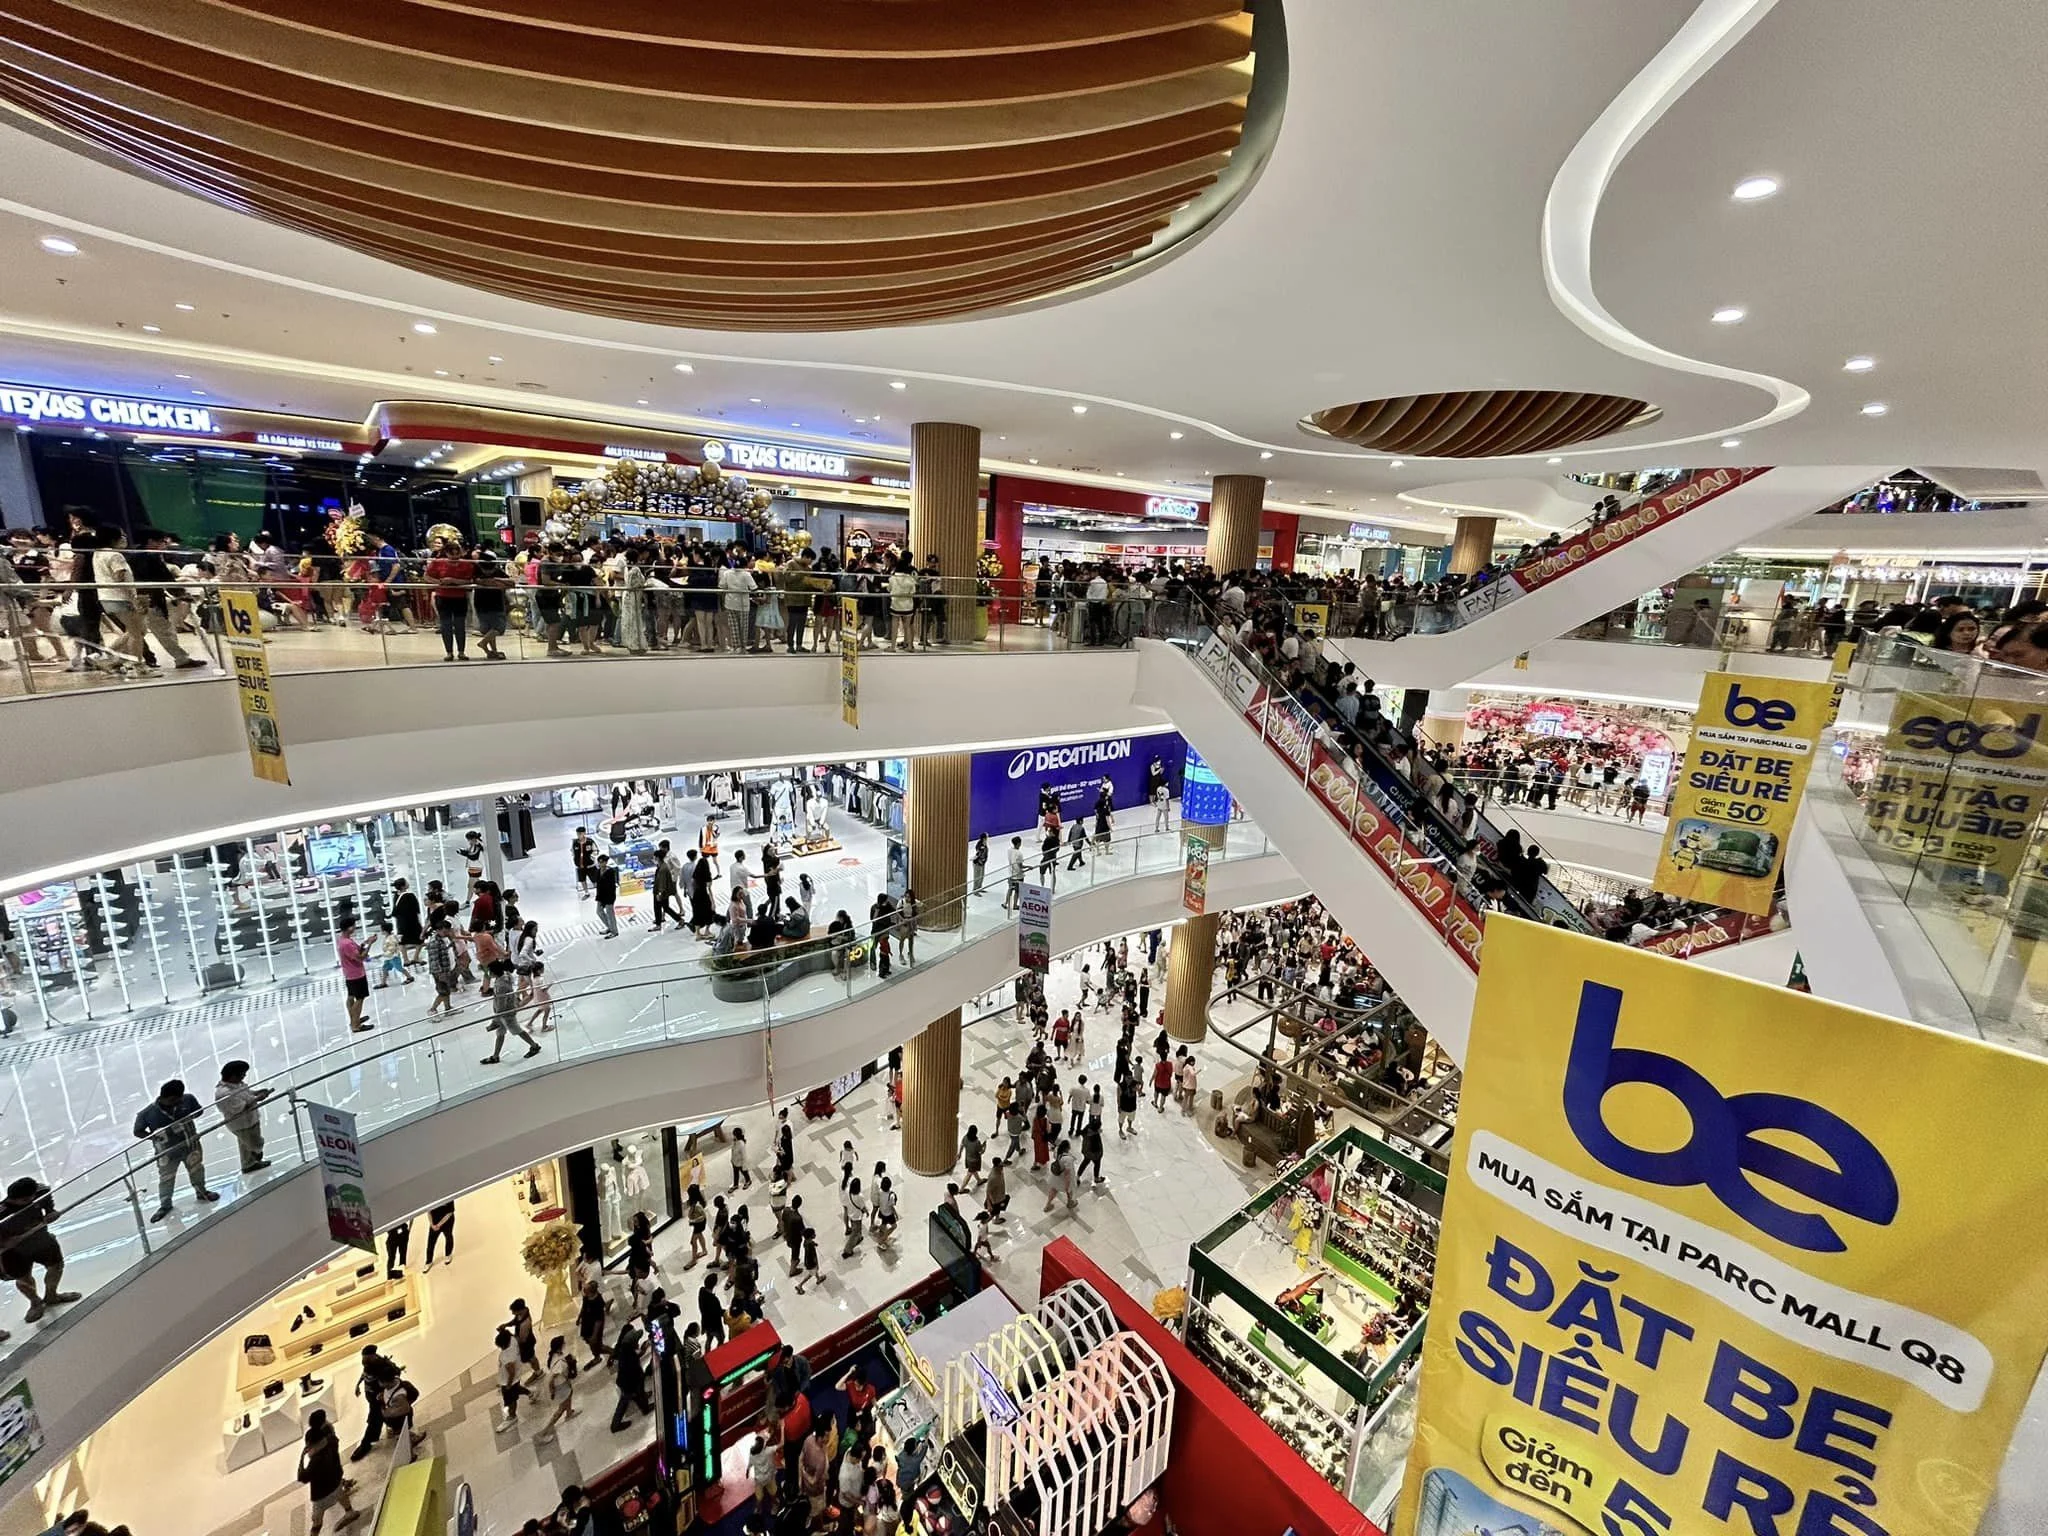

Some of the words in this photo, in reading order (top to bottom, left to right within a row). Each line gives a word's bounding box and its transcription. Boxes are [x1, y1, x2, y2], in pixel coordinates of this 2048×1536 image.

[0, 390, 86, 420] TEXAS
[729, 443, 778, 469] TEXAS
[779, 449, 846, 476] CHICKEN
[227, 598, 251, 635] be
[1302, 607, 1320, 623] be
[1208, 644, 1252, 694] PARC
[1725, 683, 1796, 731] be
[1036, 739, 1131, 772] DECATHLON
[1699, 731, 1717, 739] MUA
[1749, 736, 1772, 747] PARC
[1771, 738, 1794, 750] MALL
[1754, 757, 1794, 778] BE
[1689, 769, 1751, 796] SIÊU
[1753, 778, 1793, 803] RẺ
[1021, 900, 1049, 914] AEON
[1563, 980, 1900, 1253] be
[318, 1133, 357, 1156] AEON
[1478, 1151, 1537, 1199] MUA
[1543, 1191, 1613, 1231] SẮM
[1621, 1217, 1671, 1252] TẠI
[1677, 1241, 1777, 1305] PARC
[1780, 1293, 1892, 1352] MALL
[1900, 1339, 1966, 1386] Q8
[1485, 1235, 1695, 1371] ĐẶT
[1703, 1338, 1894, 1481] BE
[1455, 1310, 1690, 1477] SIÊU
[1499, 1426, 1594, 1489] Giảm
[1505, 1461, 1572, 1505] đến
